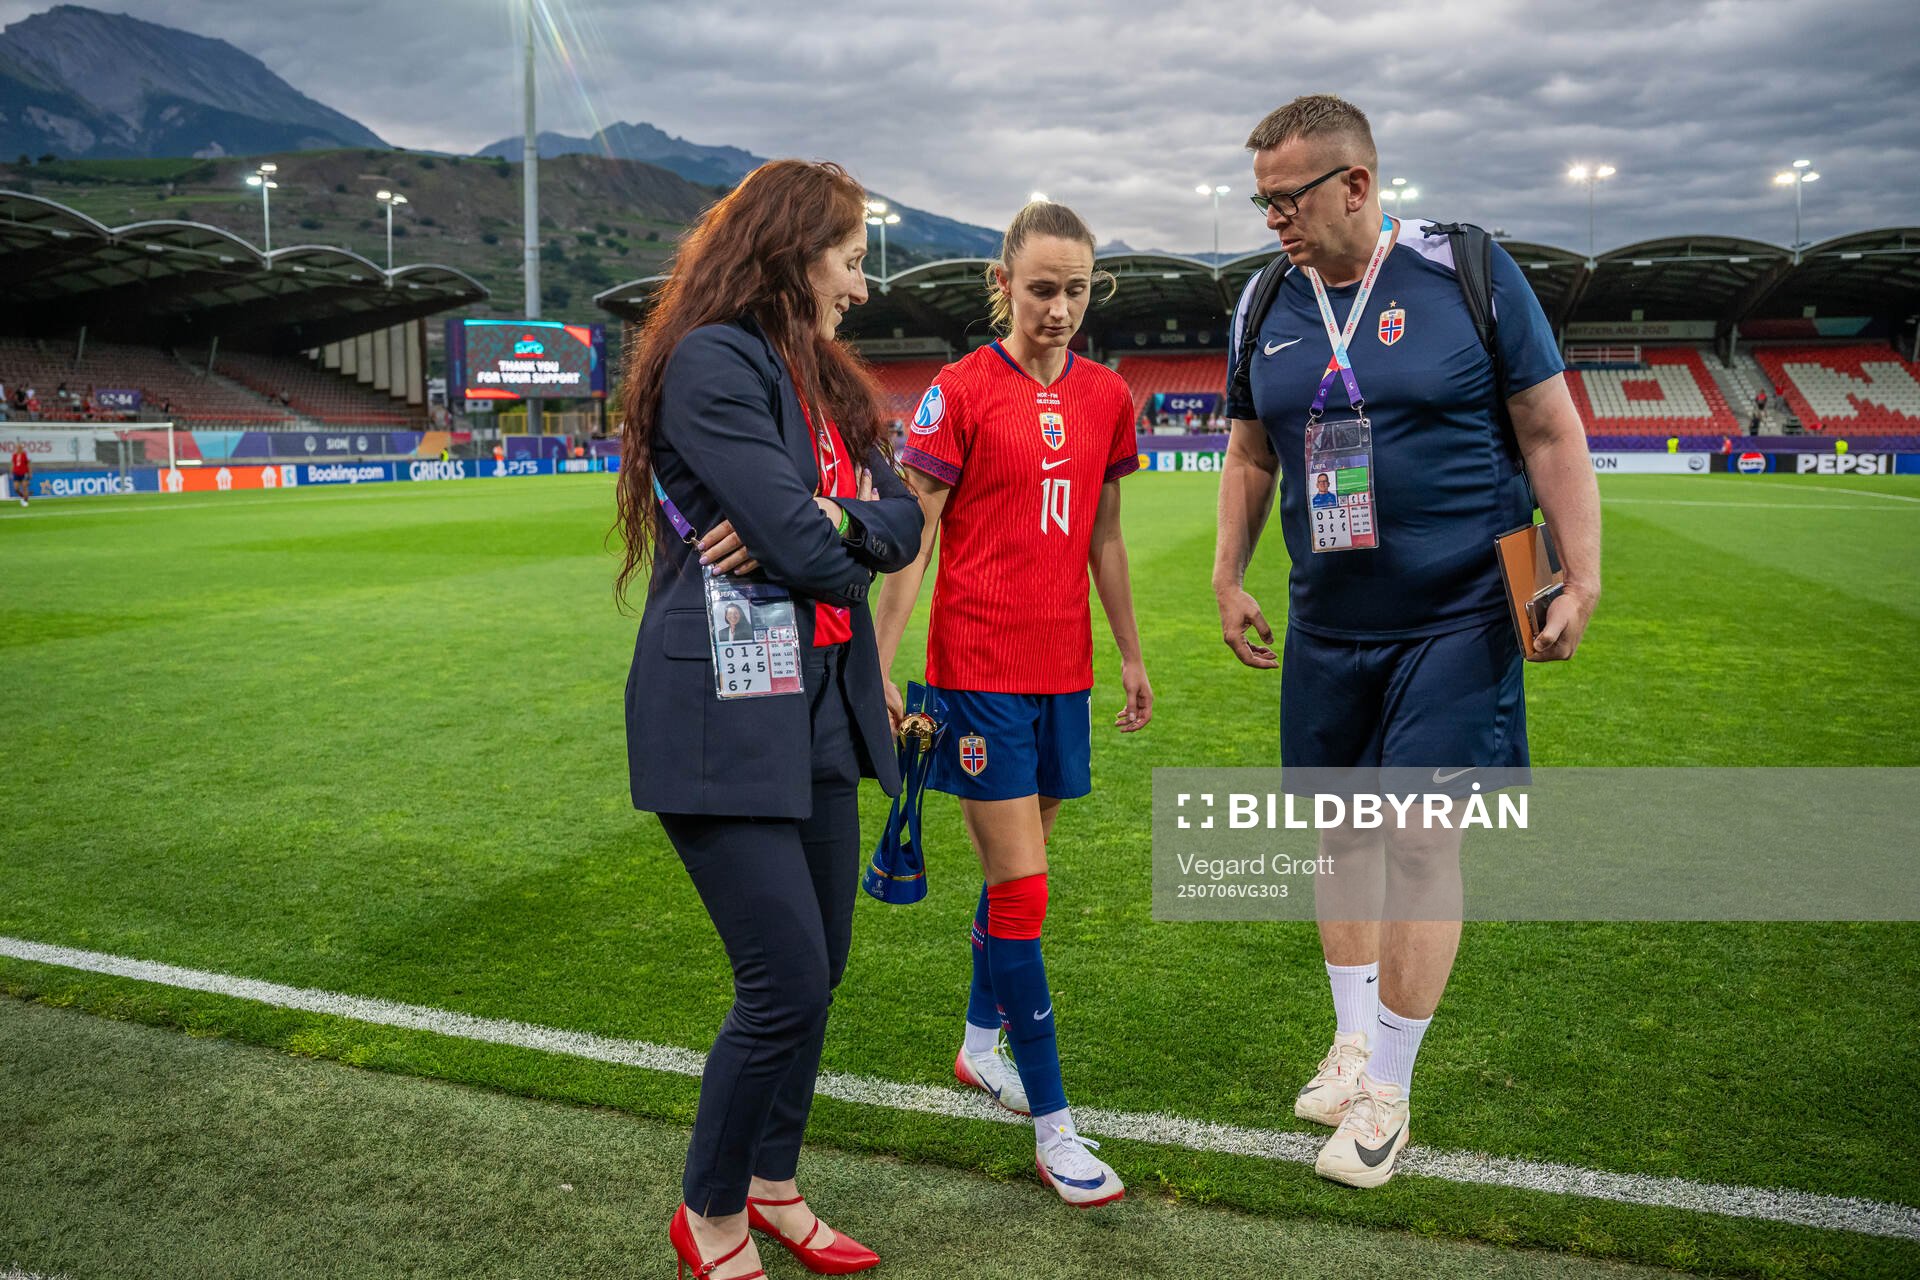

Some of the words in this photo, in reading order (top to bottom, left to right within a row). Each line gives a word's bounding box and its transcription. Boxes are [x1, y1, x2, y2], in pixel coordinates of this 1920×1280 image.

[498, 360, 536, 372] THANK
[536, 361, 559, 372] YOU
[477, 372, 500, 383] FOR
[501, 372, 530, 383] YOUR
[532, 372, 581, 384] SUPPORT
[1170, 400, 1204, 409] C2-C4
[508, 461, 538, 475] PS5
[1182, 452, 1224, 471] Hei
[1592, 458, 1617, 468] ION
[1796, 453, 1887, 474] PEPSI
[308, 465, 384, 483] Booking.com
[409, 461, 465, 481] GRIFOLS
[52, 472, 134, 495] euronics
[1040, 478, 1070, 536] 10
